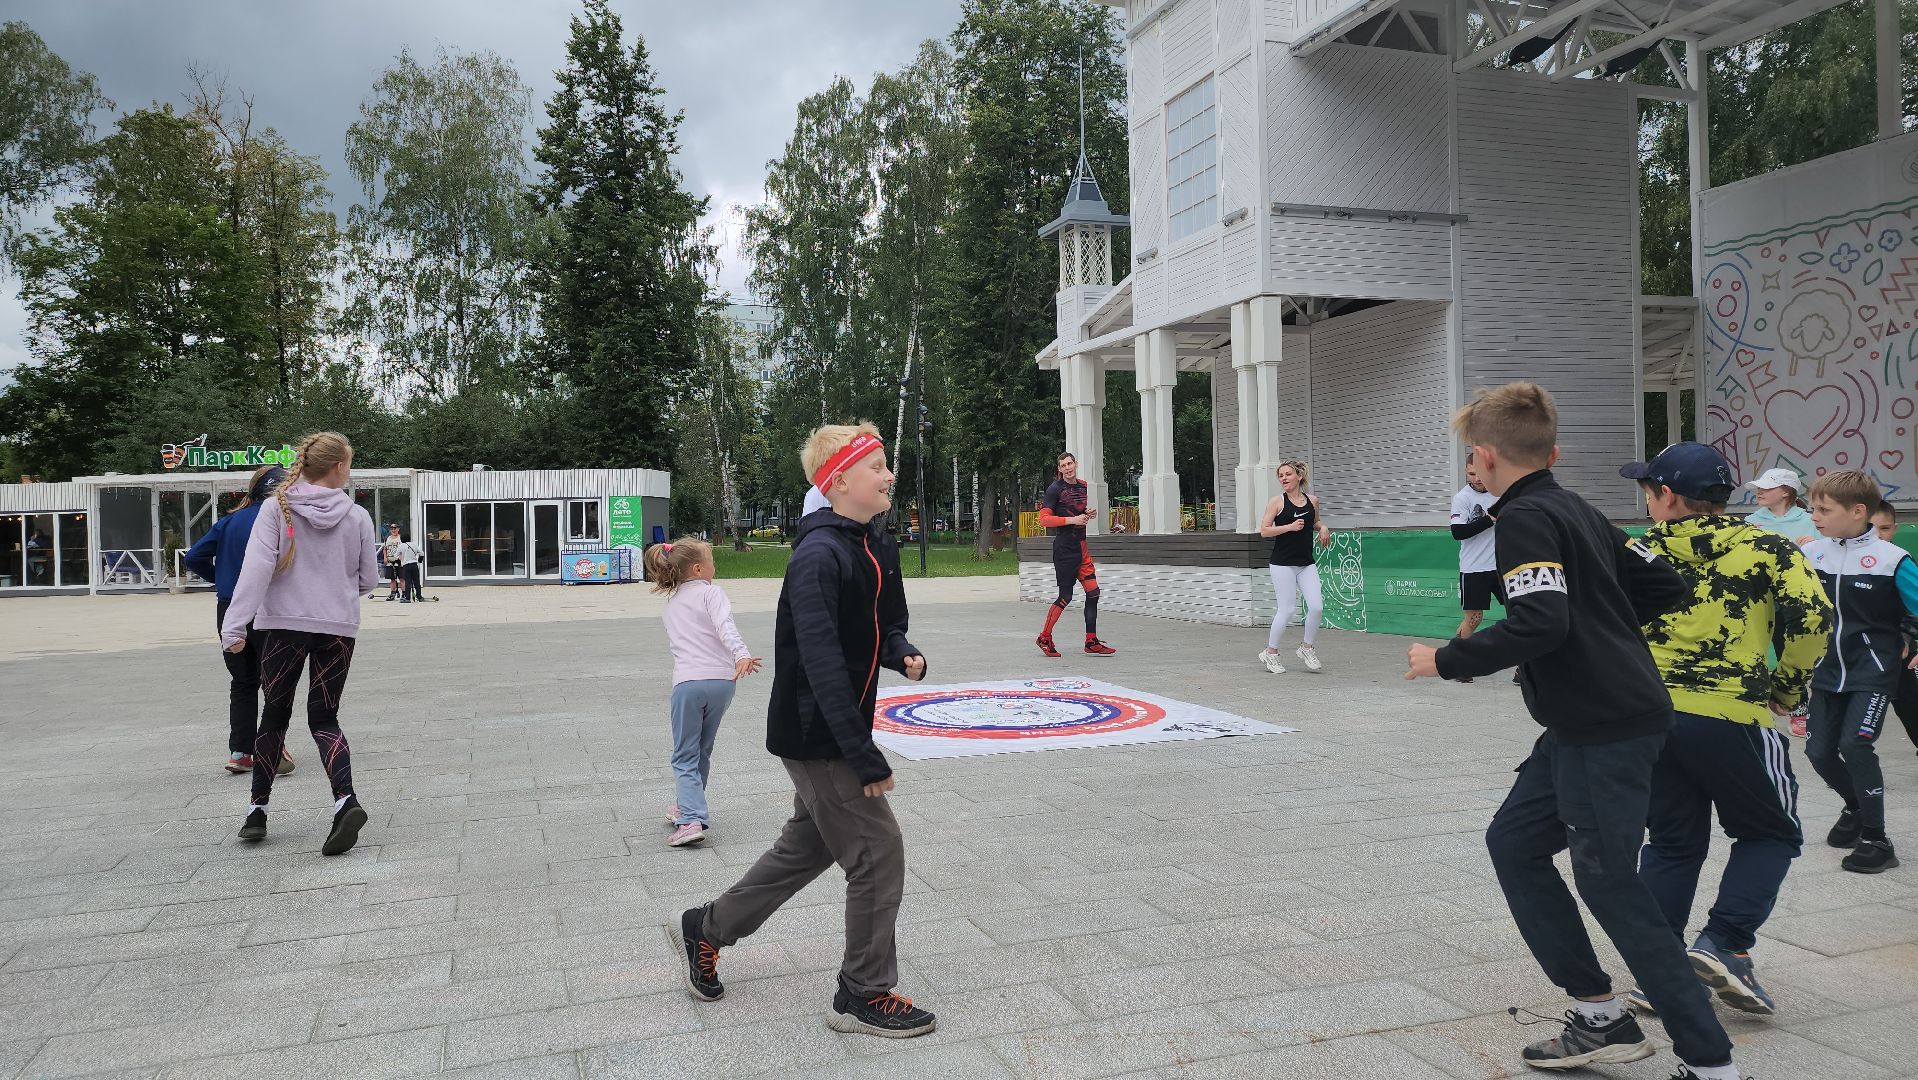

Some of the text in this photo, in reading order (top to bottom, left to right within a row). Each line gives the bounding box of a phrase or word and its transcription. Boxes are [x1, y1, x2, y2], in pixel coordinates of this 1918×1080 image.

[187, 444, 298, 469] ПаркКаф
[1396, 580, 1417, 588] ПАРКИ
[1396, 587, 1448, 598] ПОДМОСКОВЬЯ
